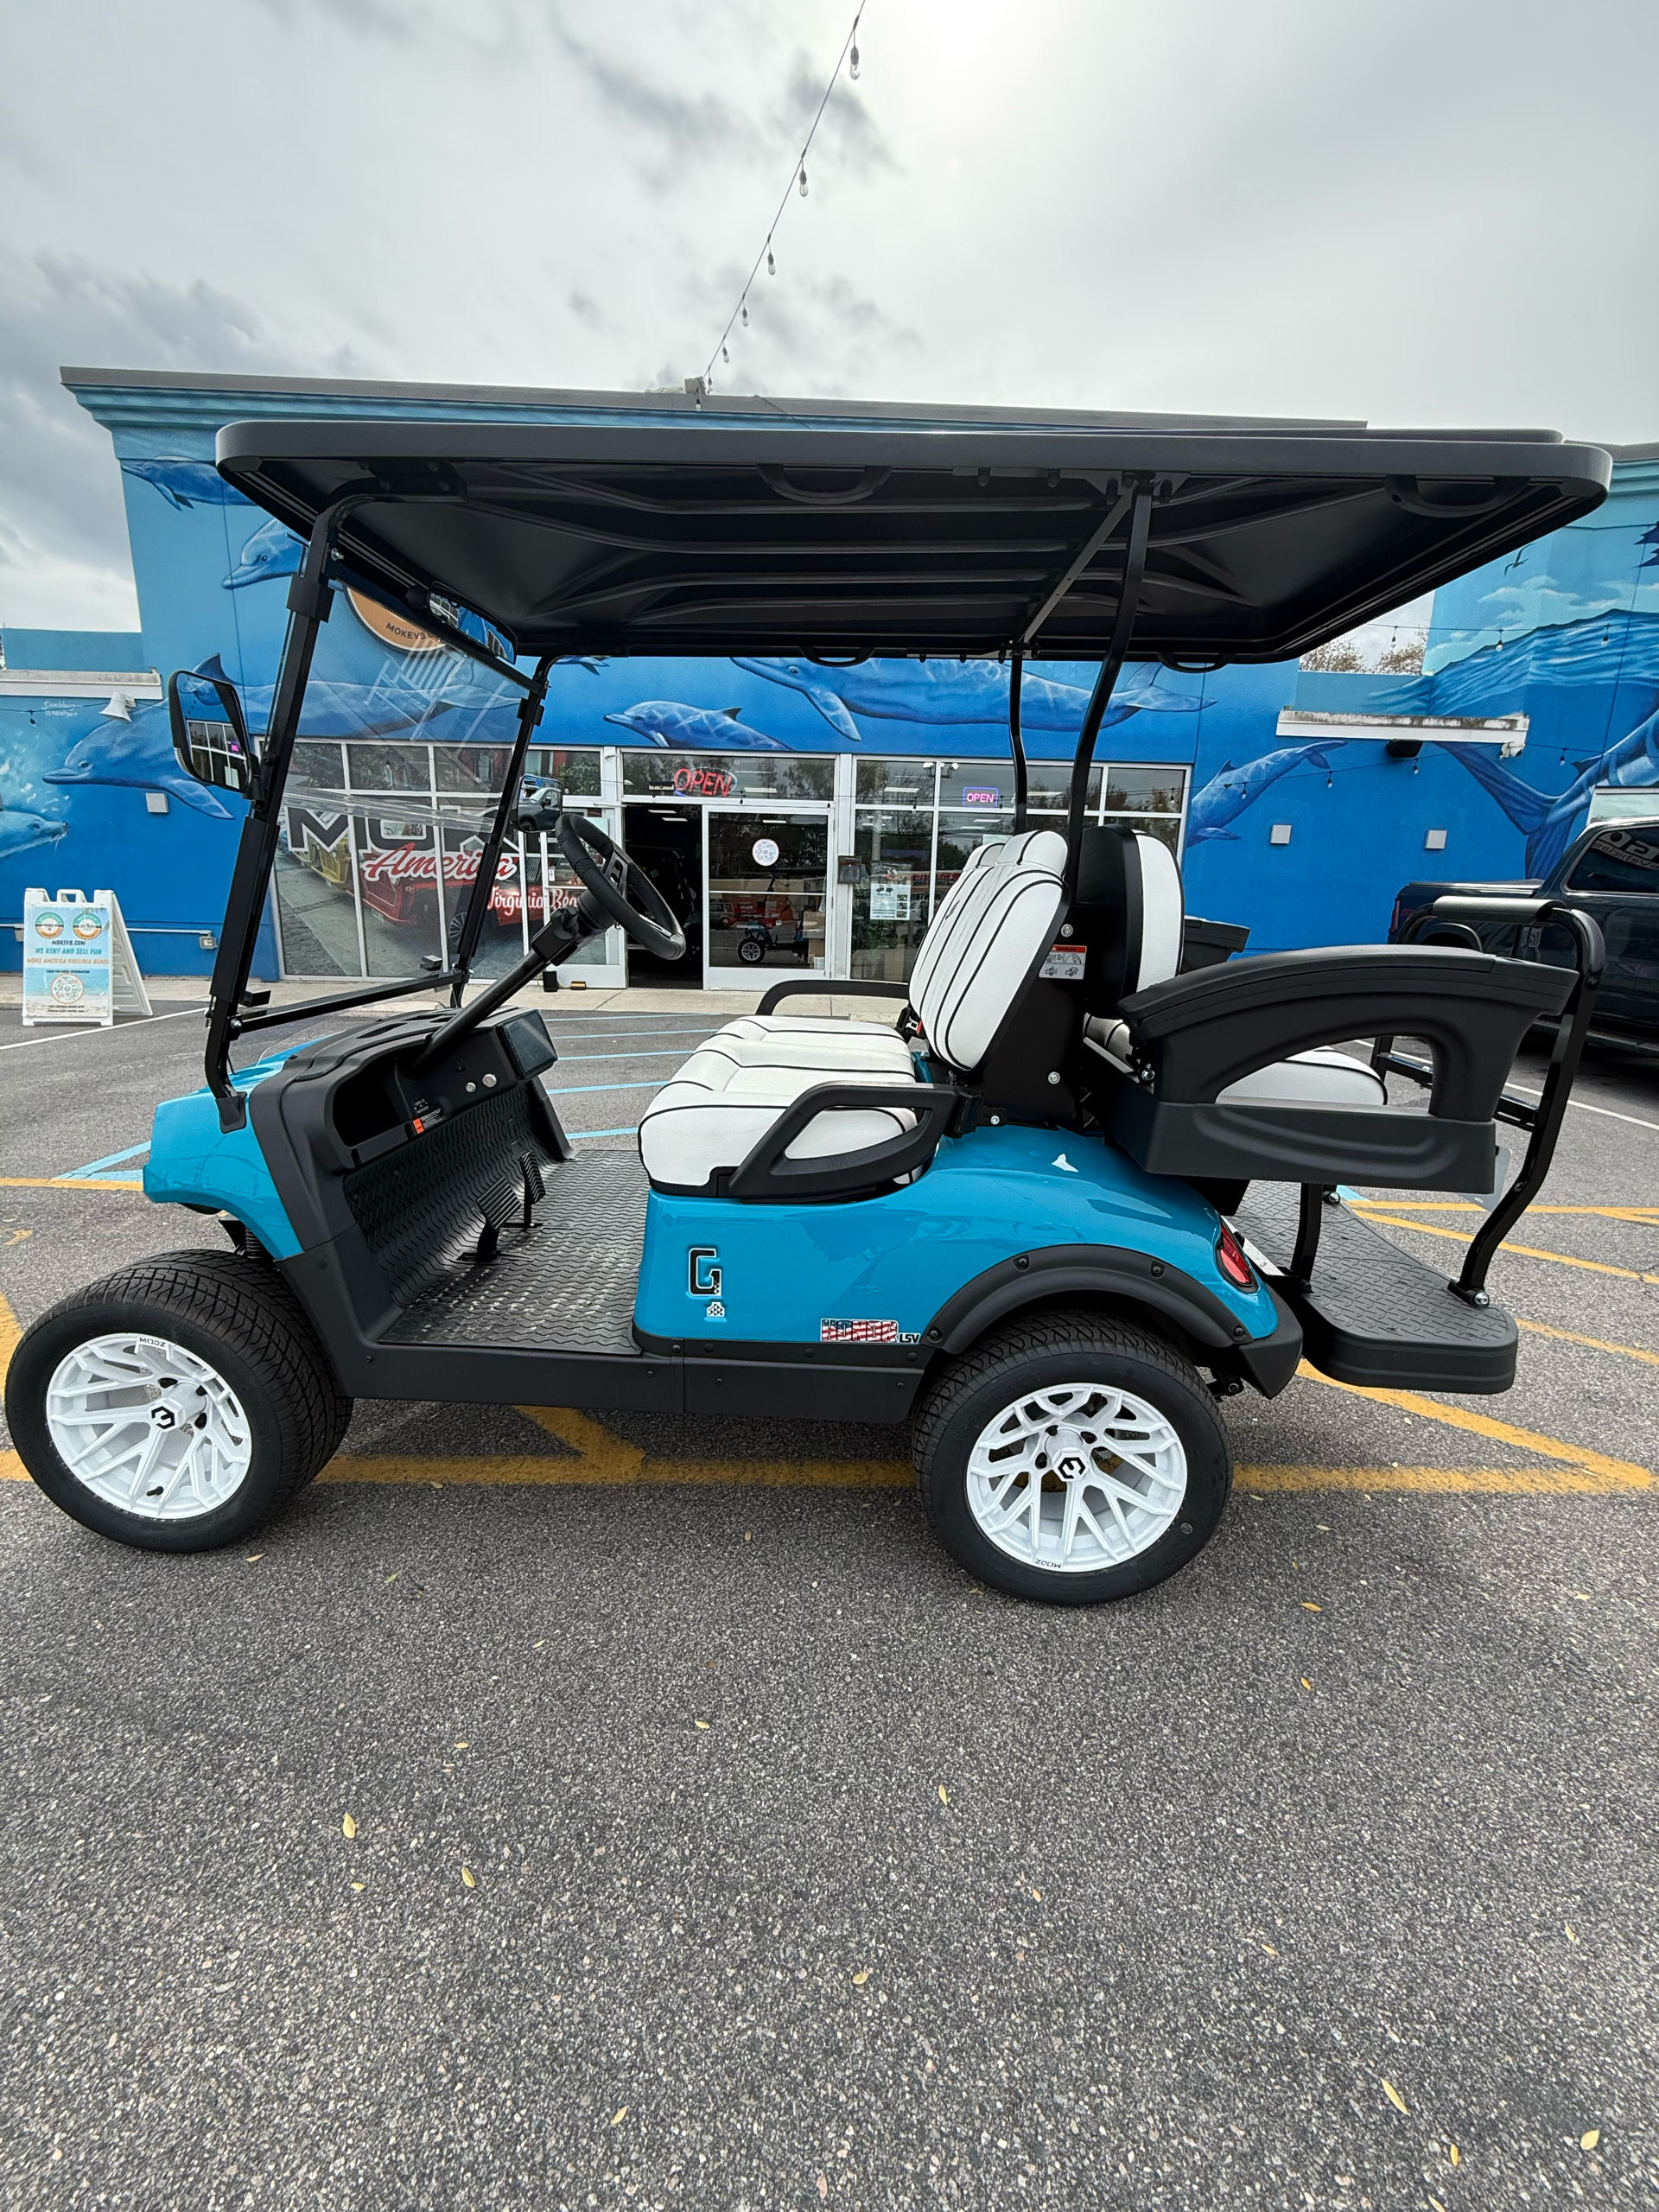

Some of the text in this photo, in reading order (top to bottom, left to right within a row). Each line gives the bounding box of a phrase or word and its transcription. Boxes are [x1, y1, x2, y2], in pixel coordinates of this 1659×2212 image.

[674, 768, 732, 798] OPEN
[966, 793, 995, 804] OPEN
[363, 842, 518, 882] Ameria
[821, 1319, 920, 1344] HONOR LSV
[139, 1337, 167, 1347] MODZ
[1034, 1559, 1062, 1569] MODZ
